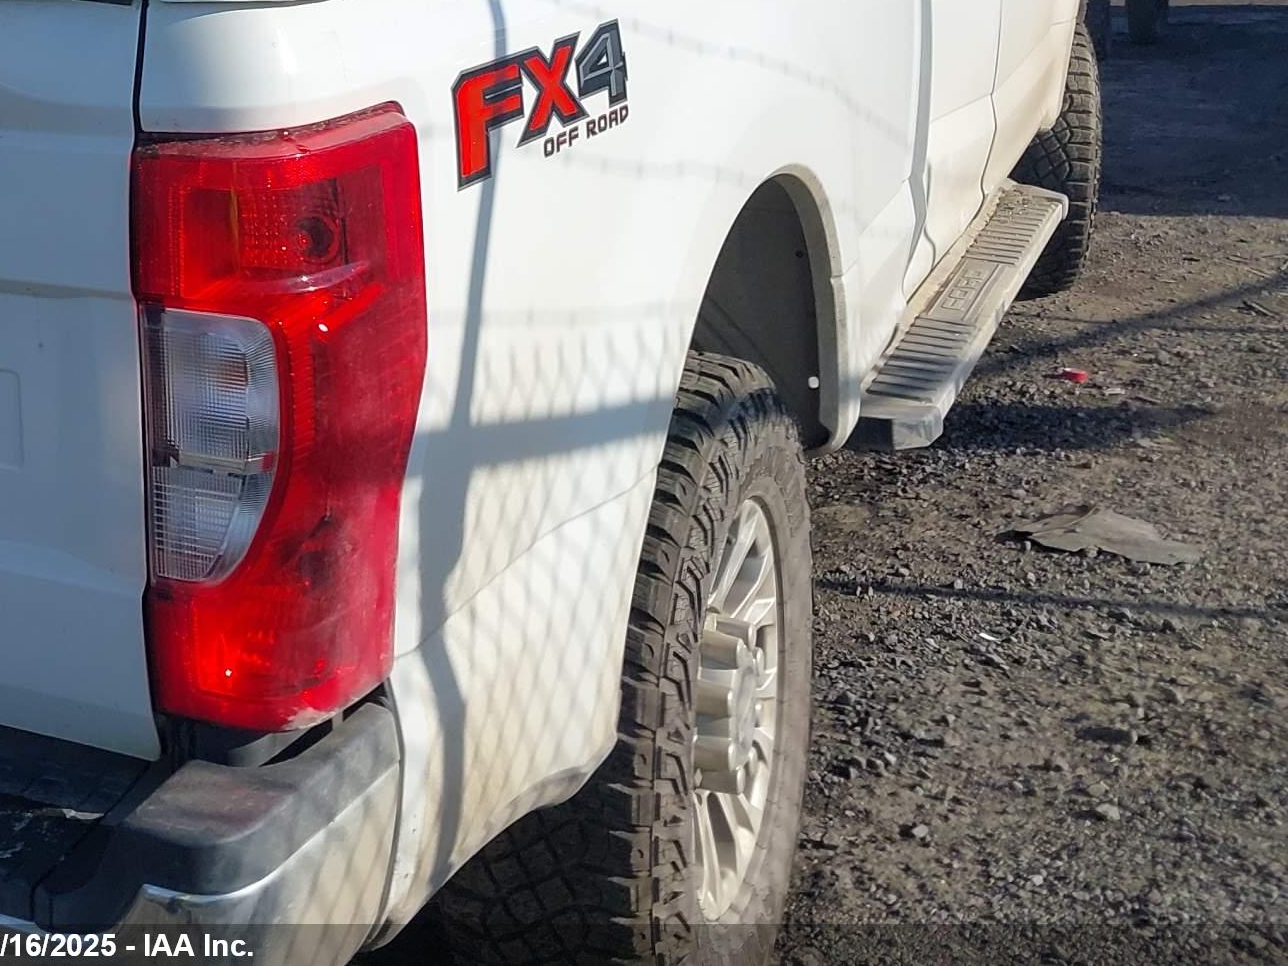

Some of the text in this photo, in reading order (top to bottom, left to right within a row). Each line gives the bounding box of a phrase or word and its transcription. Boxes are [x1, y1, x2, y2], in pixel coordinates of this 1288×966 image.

[451, 18, 628, 192] FX4
[543, 105, 629, 158] OFF ROAD
